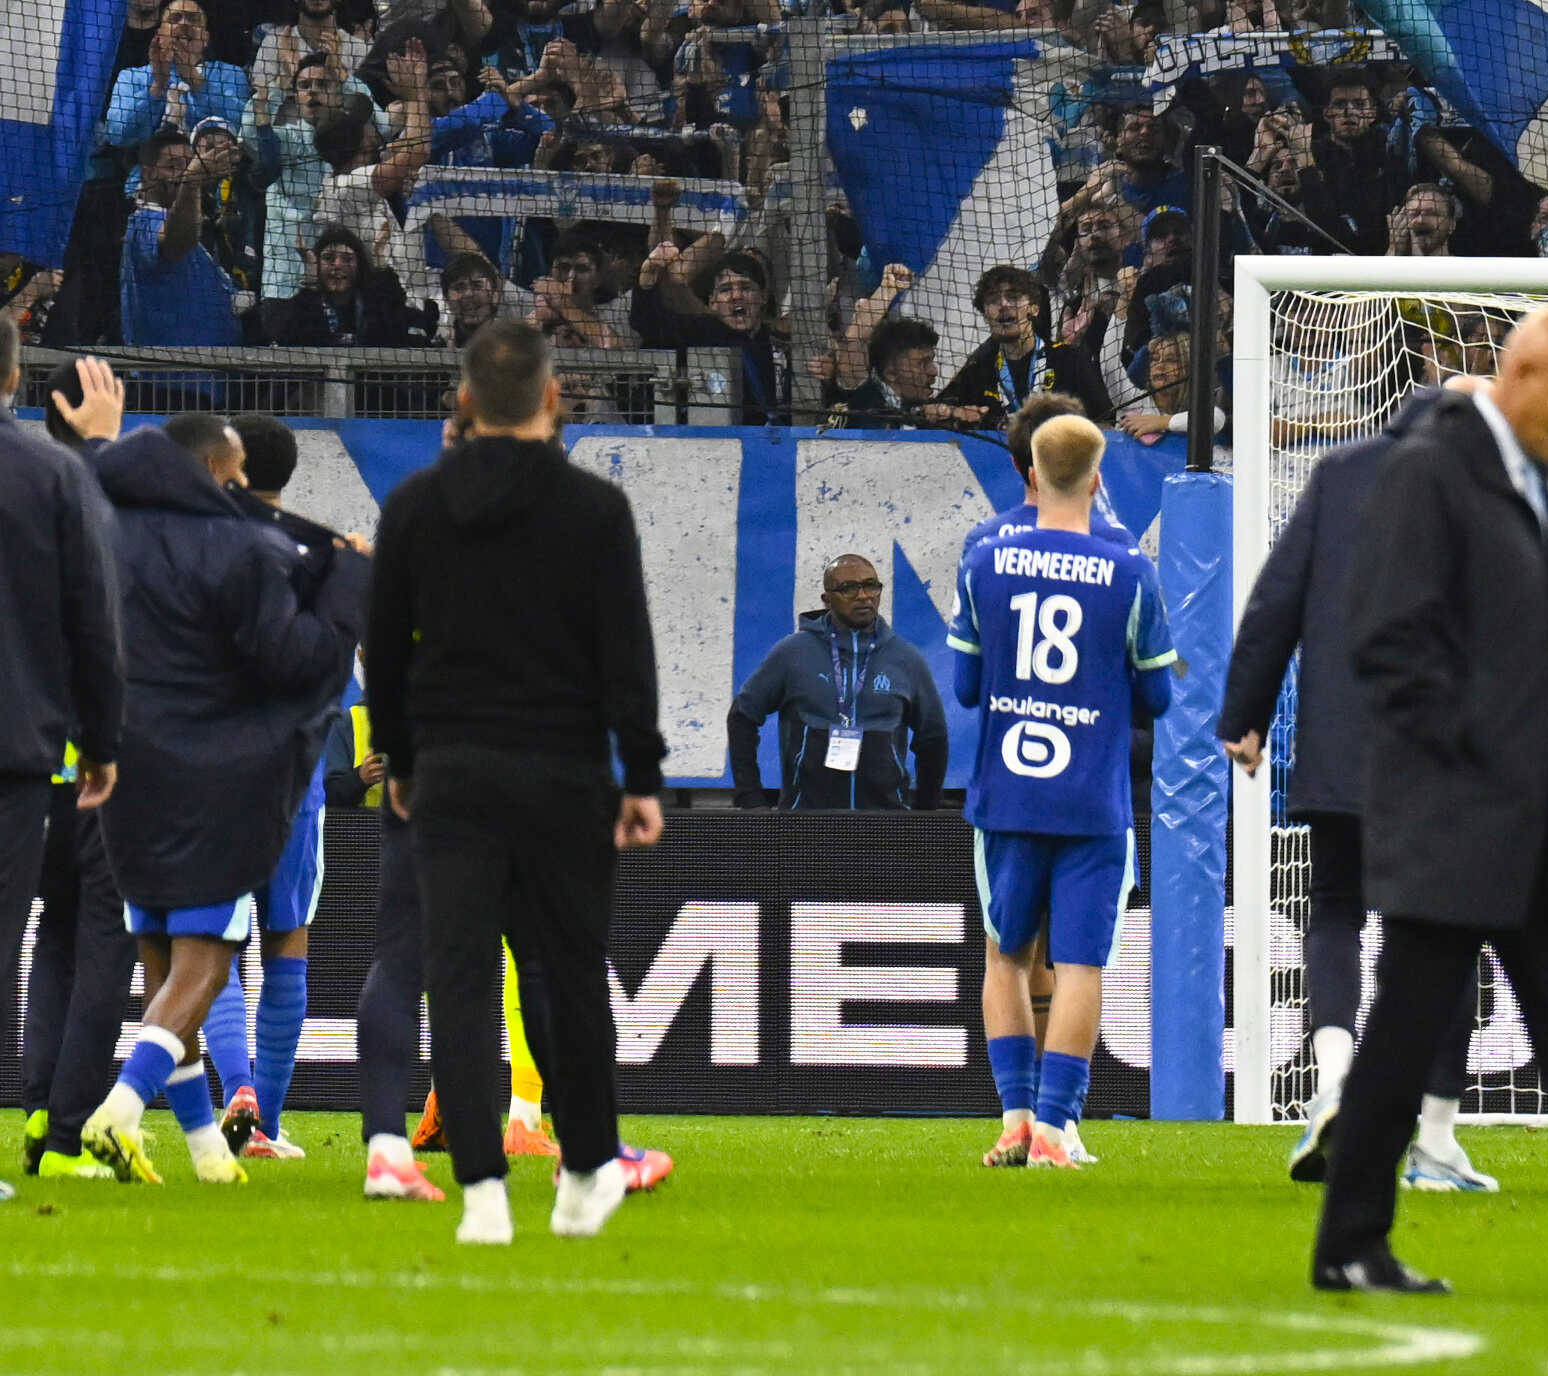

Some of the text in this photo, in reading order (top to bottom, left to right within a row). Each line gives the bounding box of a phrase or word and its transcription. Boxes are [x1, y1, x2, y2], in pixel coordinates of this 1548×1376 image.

[993, 546, 1116, 587] VERMEEREN
[1008, 591, 1083, 686] 18
[988, 693, 1101, 728] boulanger
